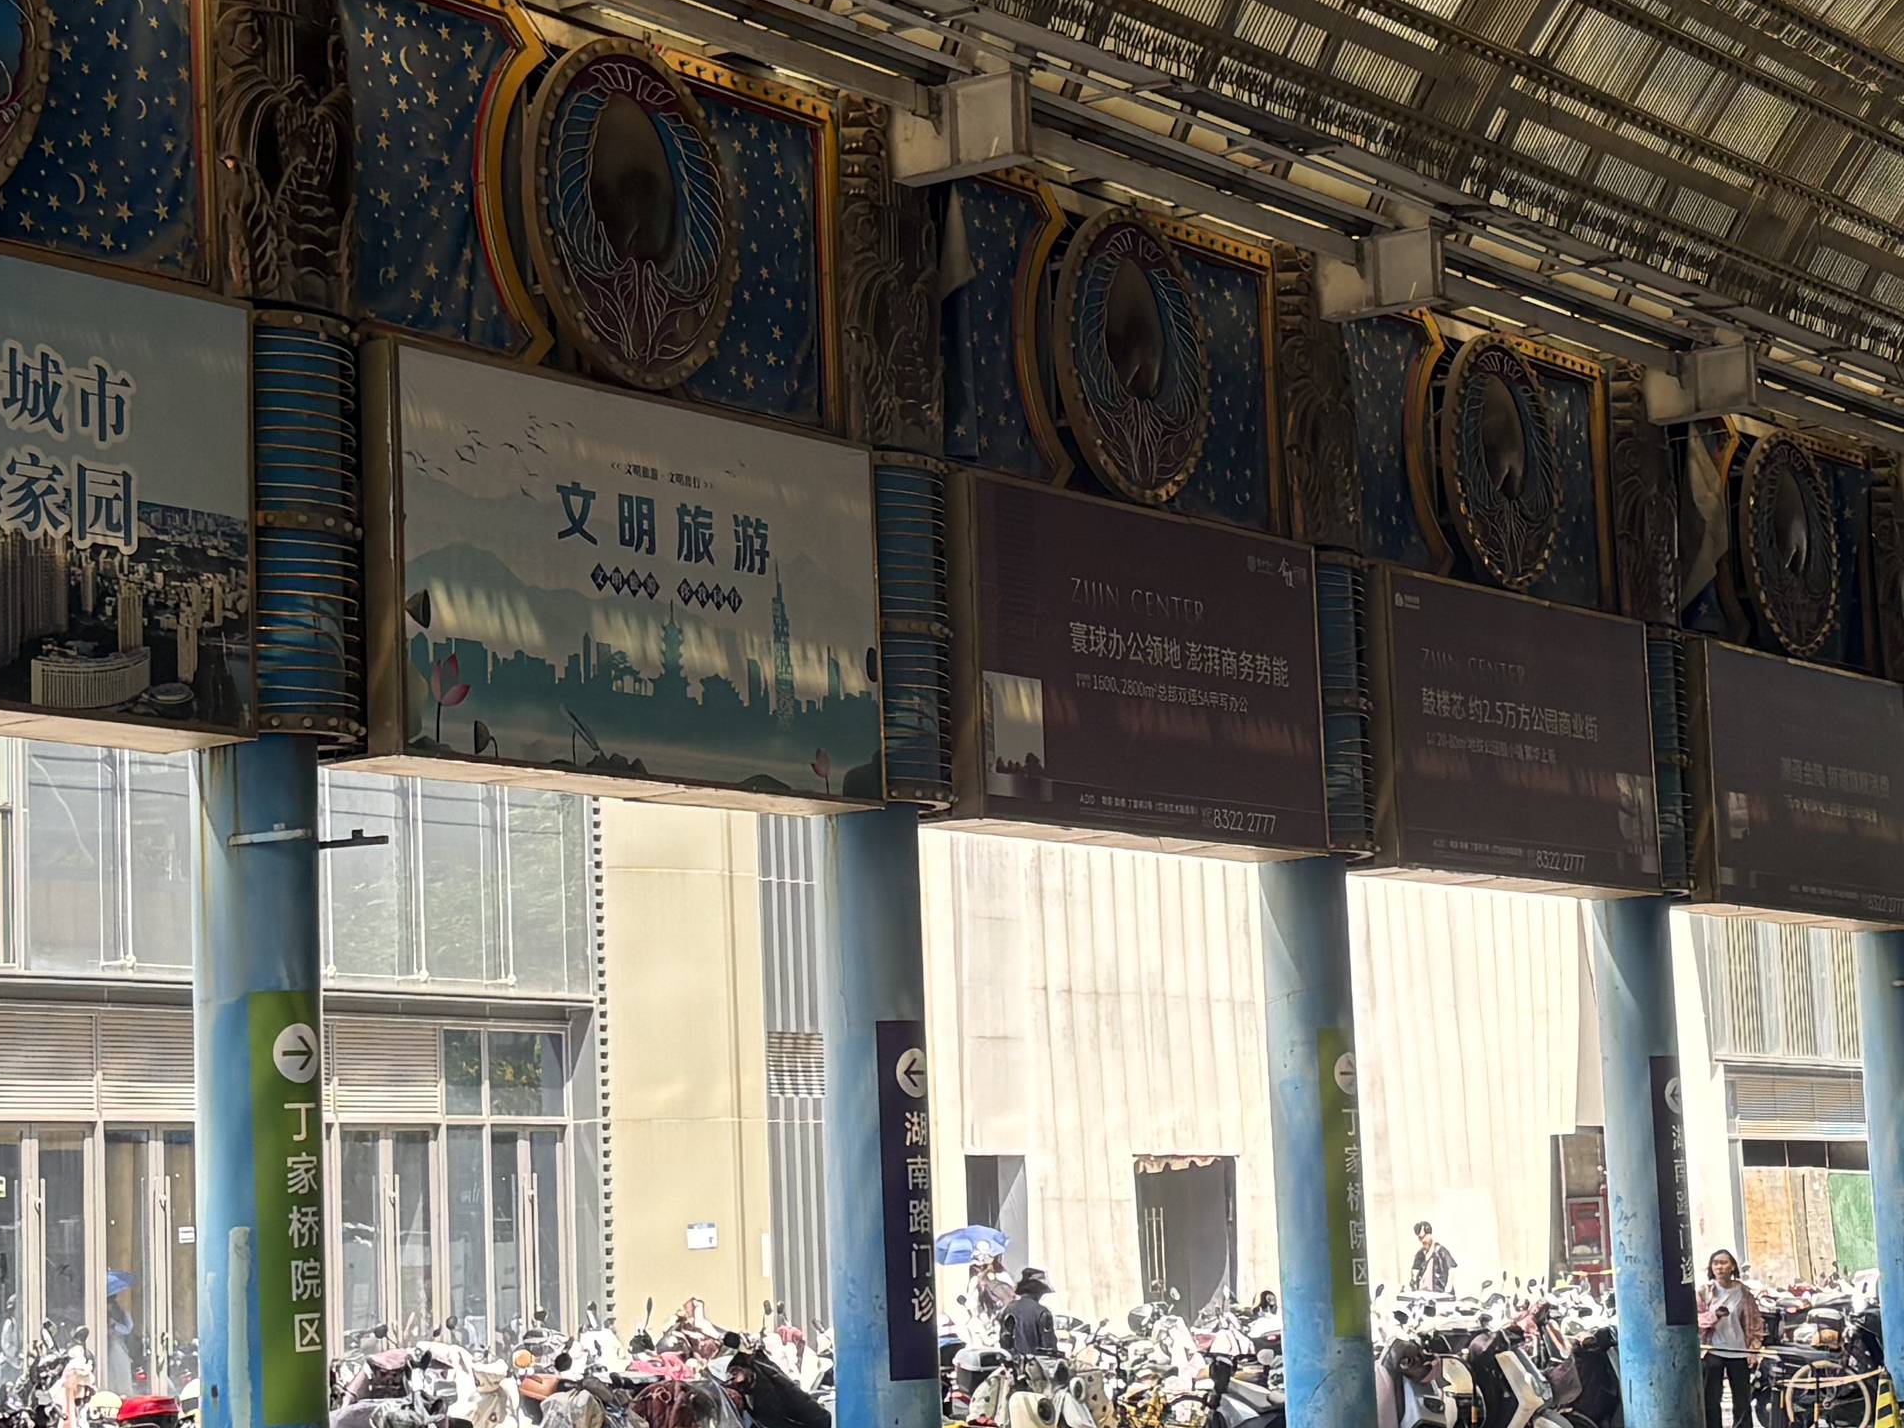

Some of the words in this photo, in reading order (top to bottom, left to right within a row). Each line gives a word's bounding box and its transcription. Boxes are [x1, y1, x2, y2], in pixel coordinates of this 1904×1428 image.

[556, 481, 770, 575] 文明旅游
[1130, 589, 1205, 624] CENTER
[1070, 621, 1182, 669] 寰球办公领地
[1186, 641, 1290, 688] 澎湃商务势能
[1213, 808, 1244, 832] 8322
[1247, 812, 1277, 836] 2777
[284, 1102, 322, 1353] 丁家桥院区
[904, 1110, 935, 1324] 湖南路门诊
